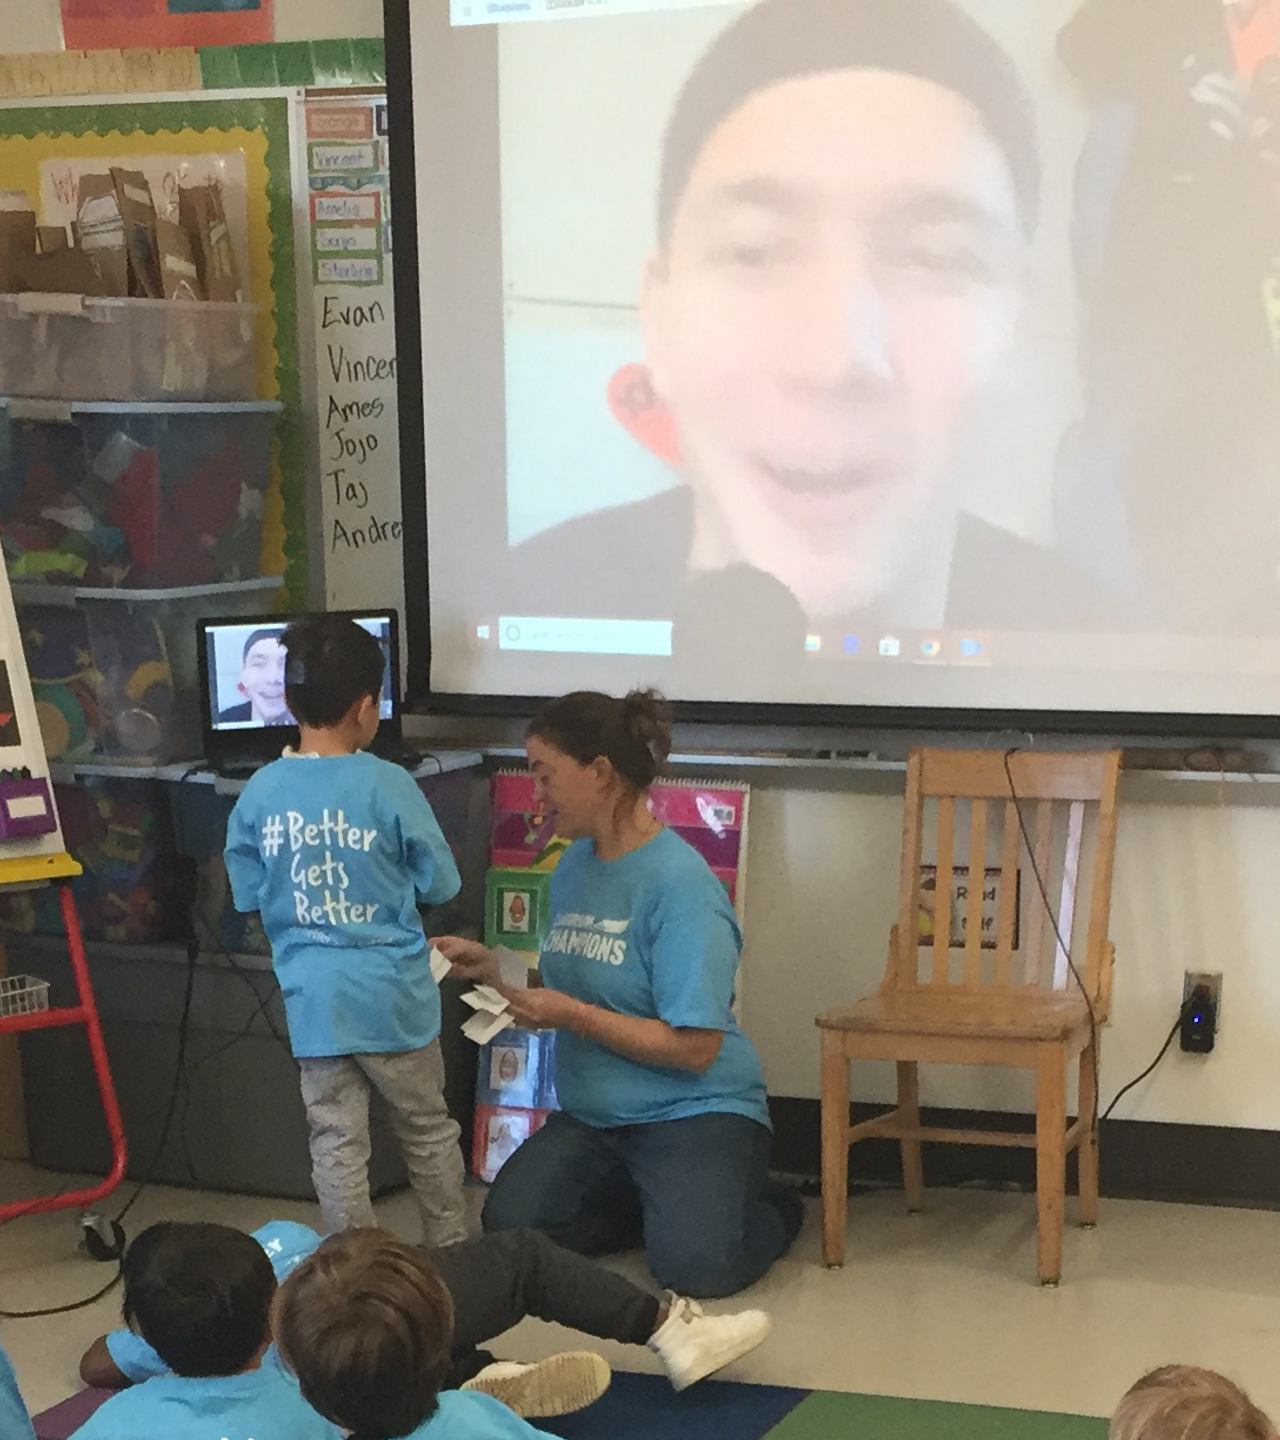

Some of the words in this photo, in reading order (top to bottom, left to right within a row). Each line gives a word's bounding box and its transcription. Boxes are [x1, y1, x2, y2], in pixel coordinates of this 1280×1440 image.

[321, 296, 385, 330] Evan
[325, 395, 385, 429] Ames
[330, 428, 379, 465] Jojo
[326, 468, 369, 509] Taj
[262, 808, 378, 857] #Better
[290, 850, 350, 891] Gets
[293, 889, 381, 926] Better
